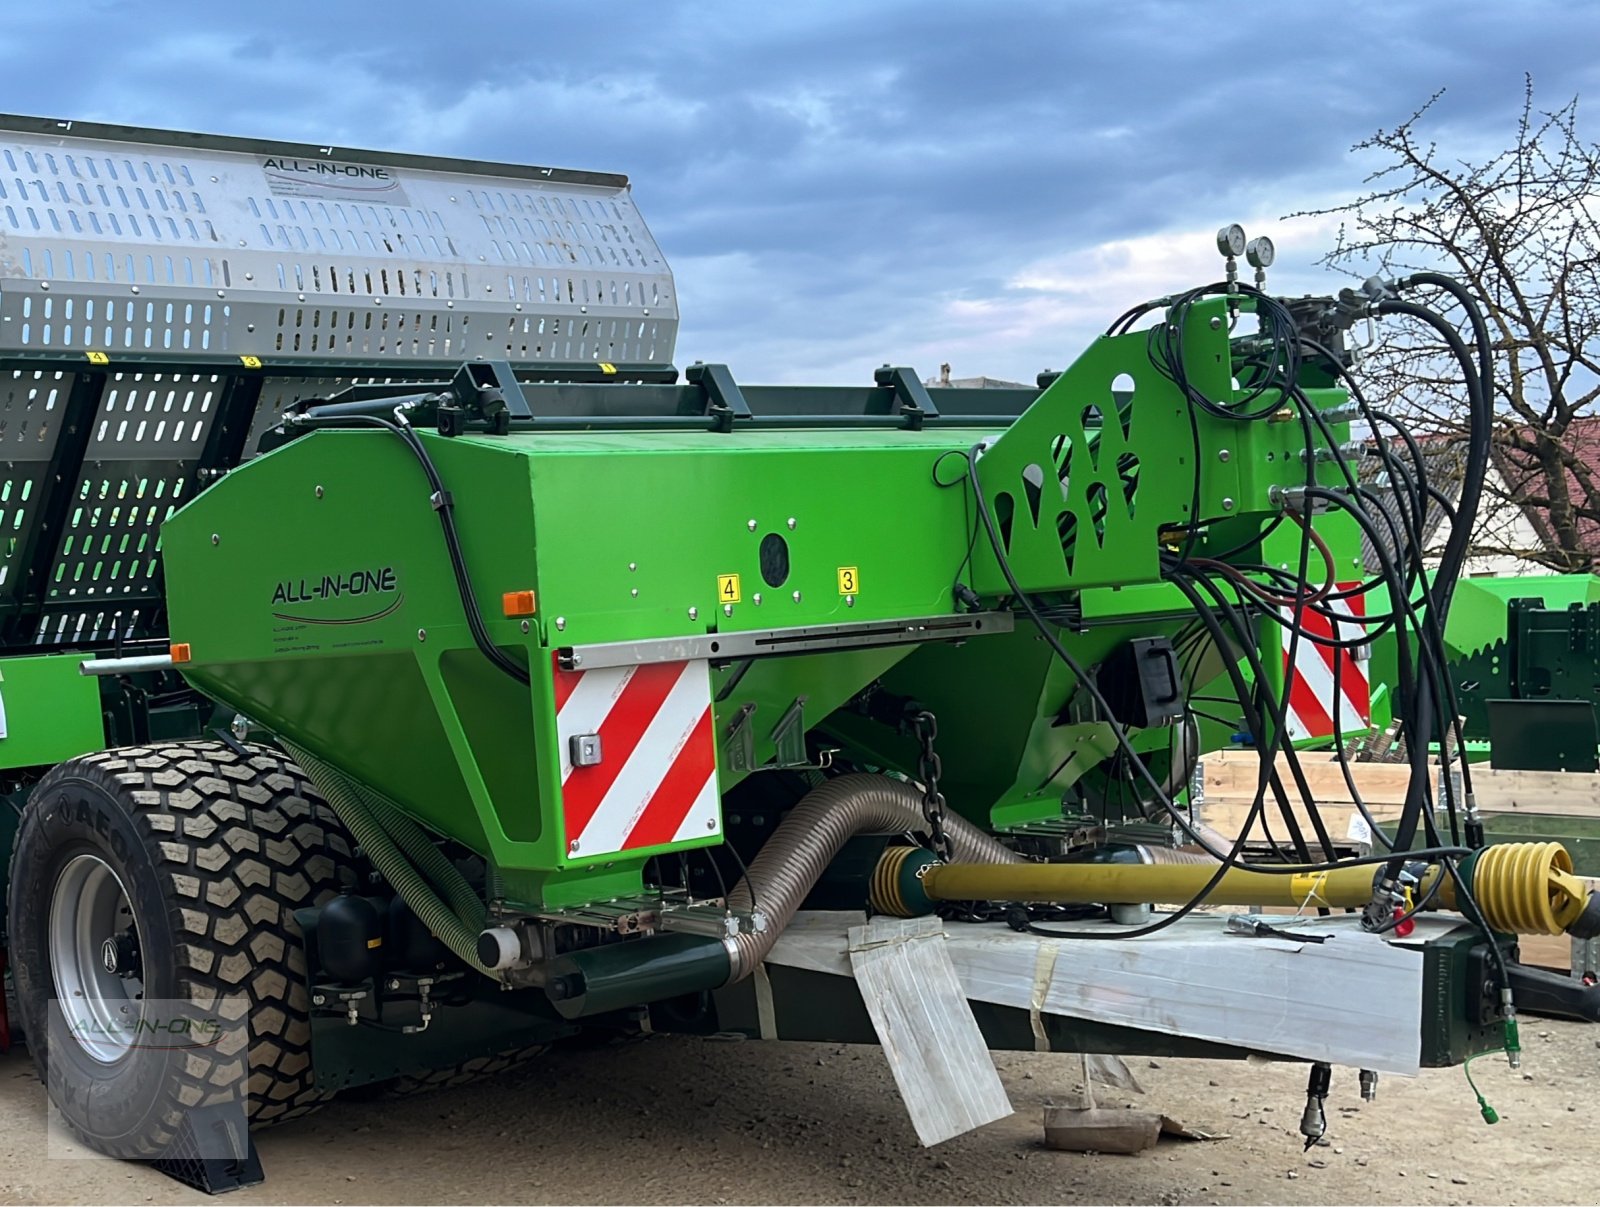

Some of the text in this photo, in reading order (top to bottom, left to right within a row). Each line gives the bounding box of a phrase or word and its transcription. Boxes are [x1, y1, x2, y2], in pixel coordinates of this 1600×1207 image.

[263, 158, 390, 180] ALL-IN-ONE
[271, 567, 397, 605] ALL-IN-ONE
[724, 579, 735, 598] 4
[843, 571, 853, 590] 3
